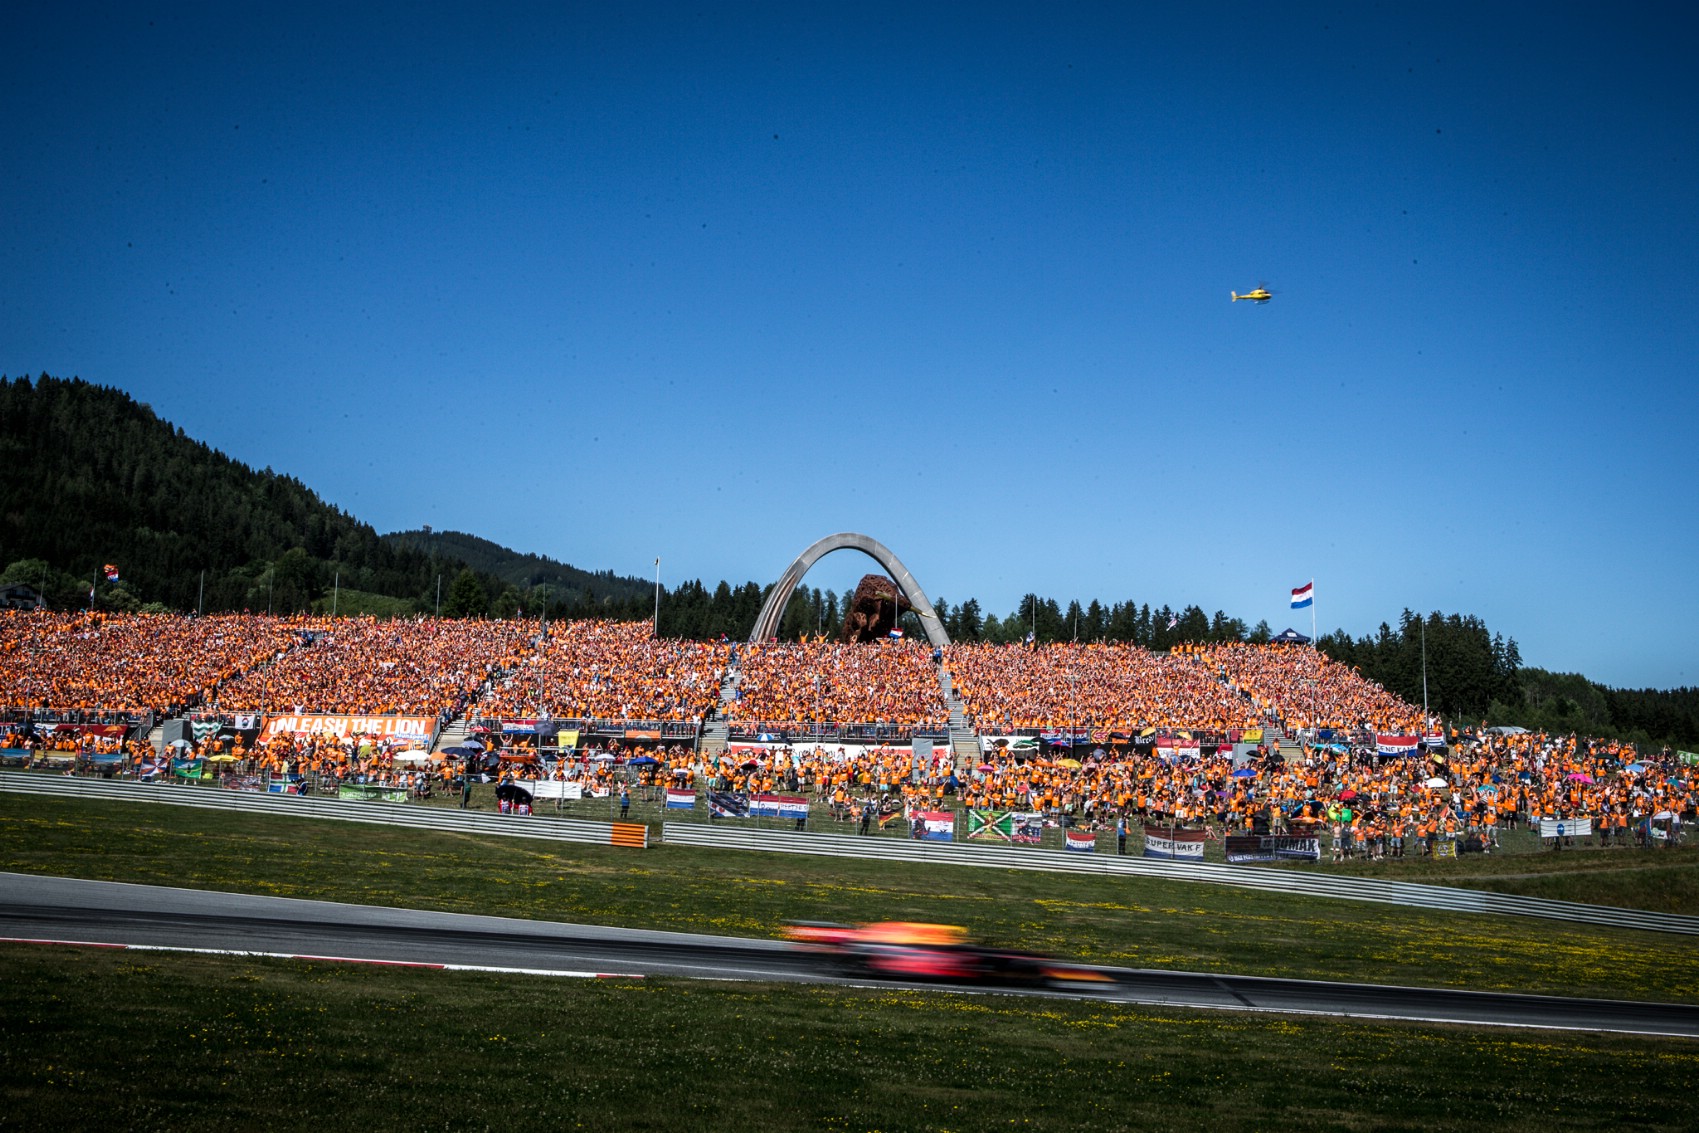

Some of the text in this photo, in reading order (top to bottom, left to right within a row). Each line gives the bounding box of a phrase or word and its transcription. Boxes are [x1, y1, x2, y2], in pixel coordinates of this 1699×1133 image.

[269, 717, 426, 735] UNLEASH THE LION
[1146, 837, 1174, 850] SUPER
[1177, 843, 1193, 852] VAK
